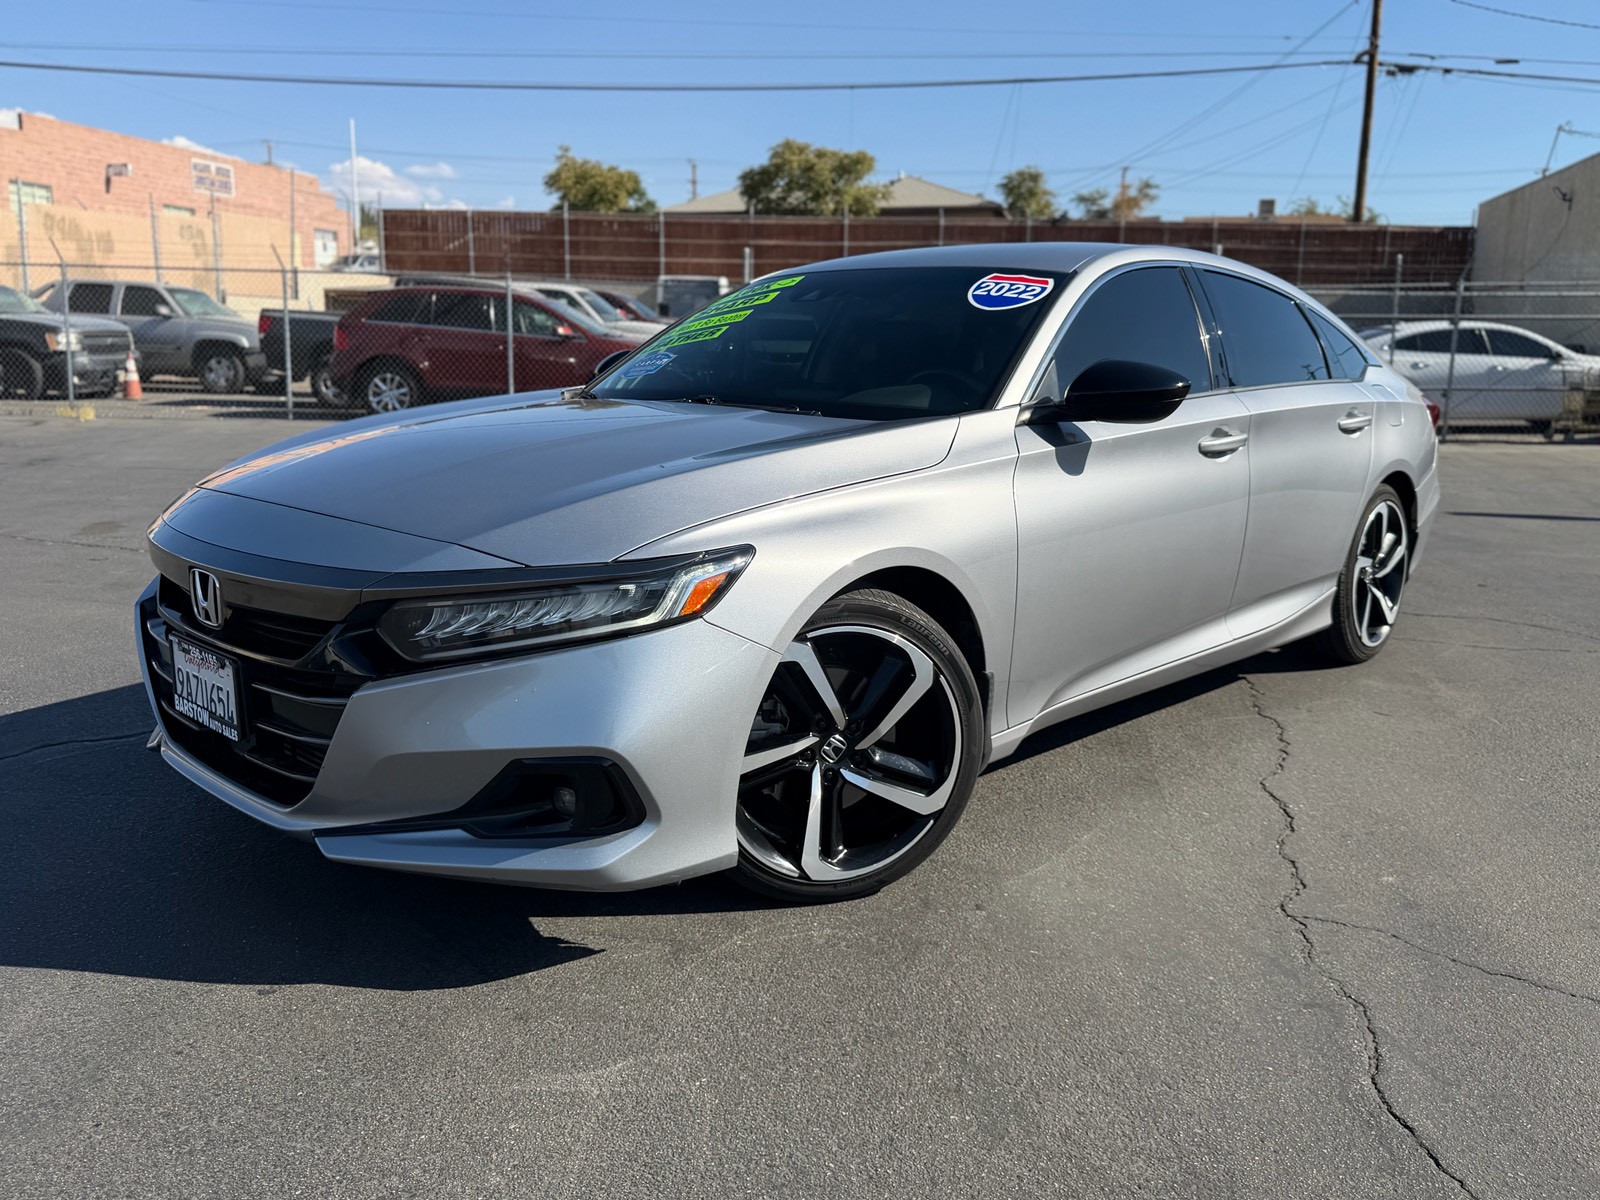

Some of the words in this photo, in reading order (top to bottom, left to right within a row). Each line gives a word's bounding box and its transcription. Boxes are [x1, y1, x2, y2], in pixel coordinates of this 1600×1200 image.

[972, 282, 1042, 300] 2022
[174, 693, 209, 727] BARSTOW
[209, 717, 222, 734] AUTO
[222, 724, 239, 742] SALES
